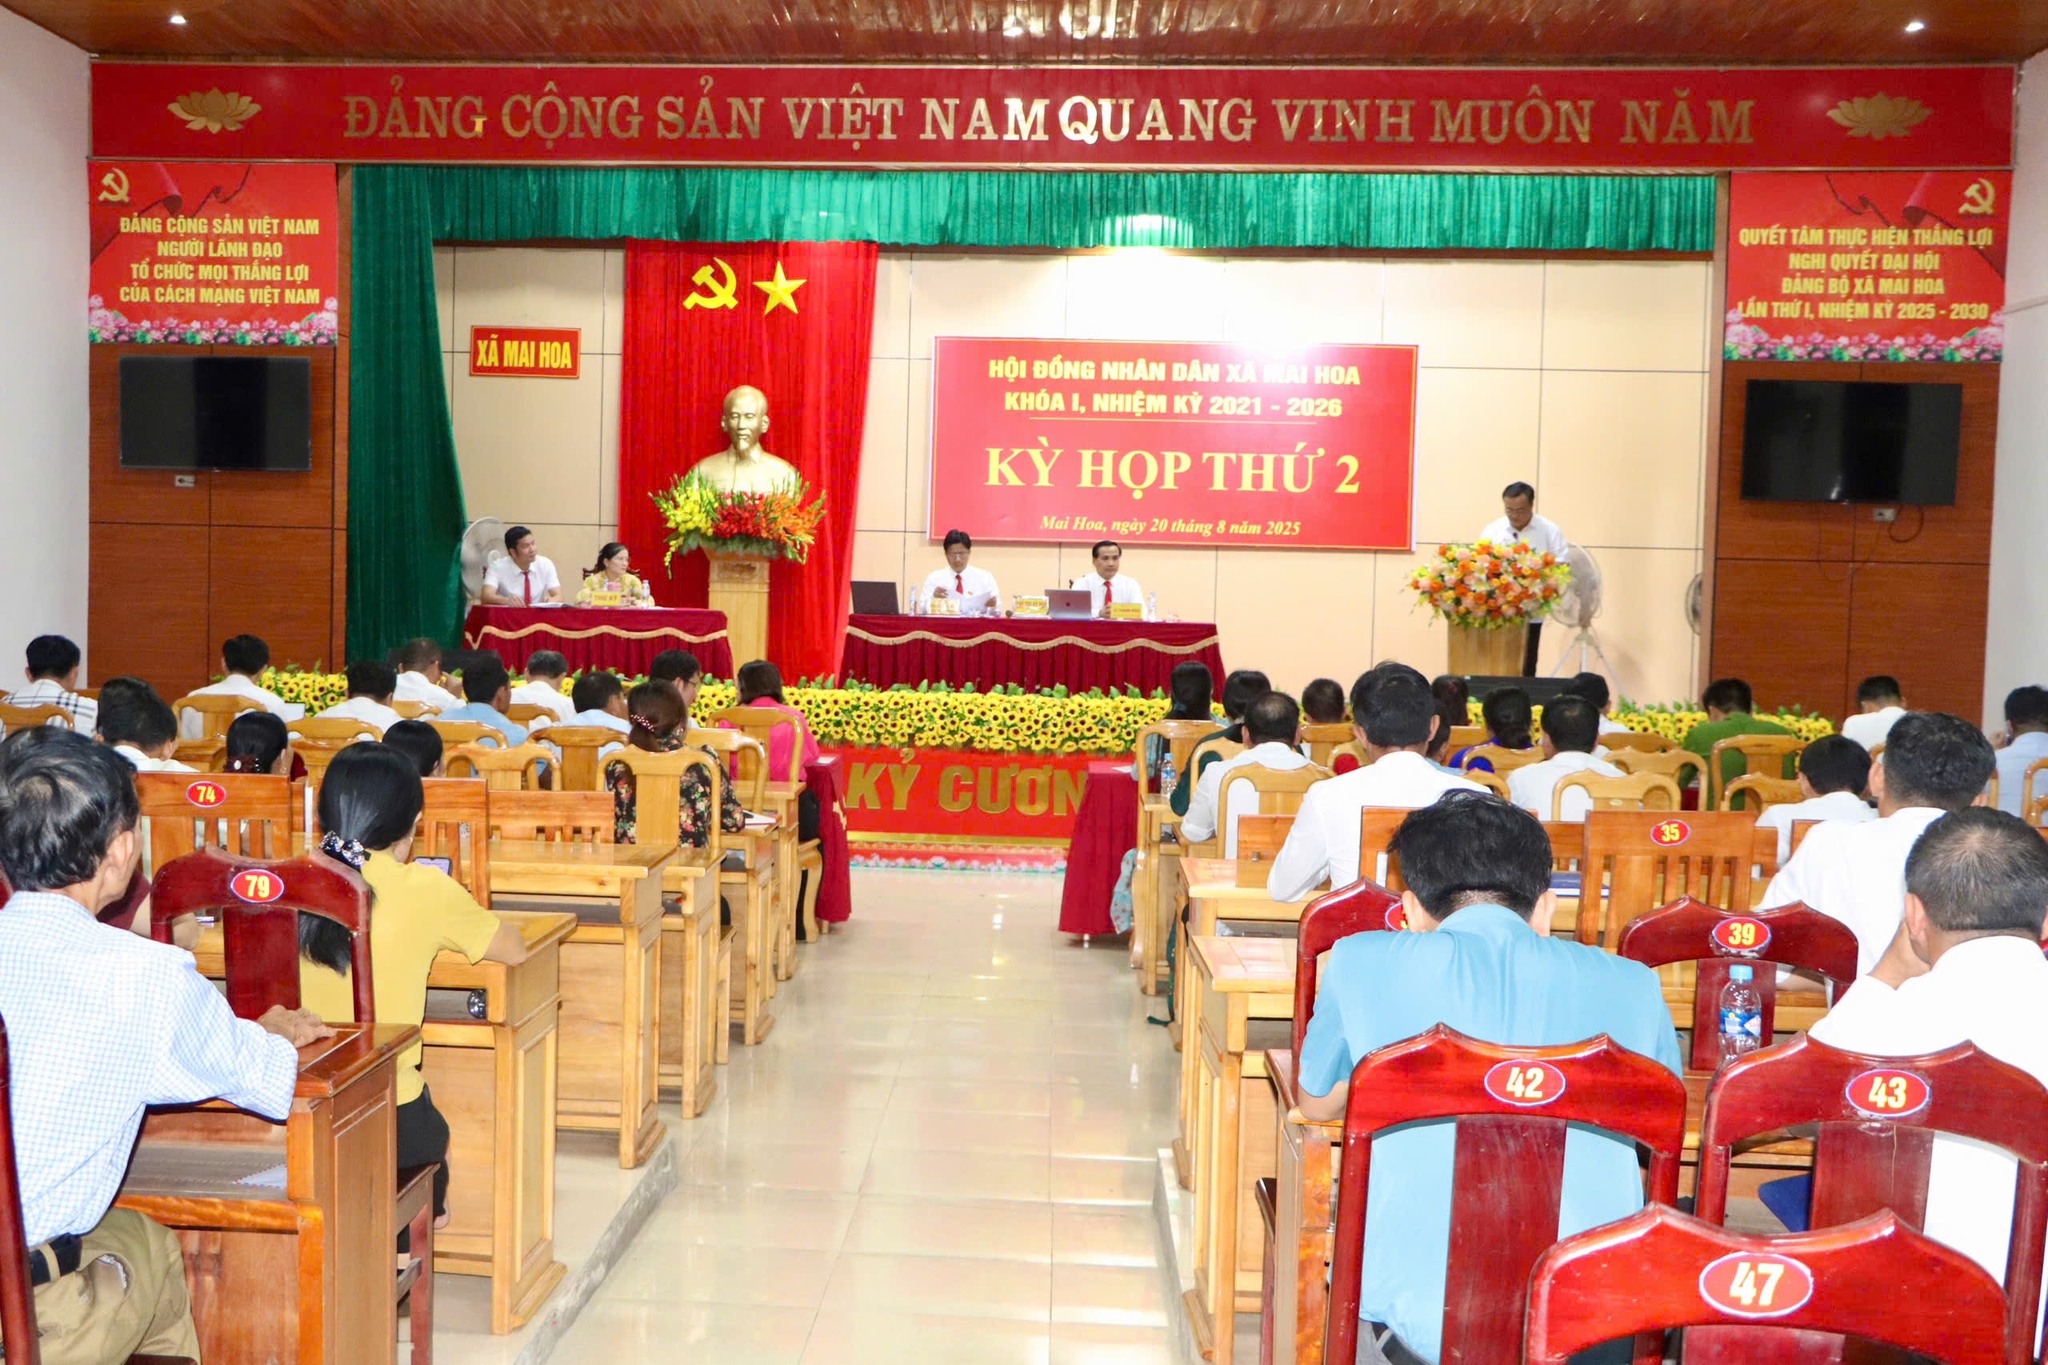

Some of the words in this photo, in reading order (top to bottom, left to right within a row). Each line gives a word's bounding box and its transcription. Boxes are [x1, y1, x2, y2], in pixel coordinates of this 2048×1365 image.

[343, 75, 487, 139] ĐẢNG
[502, 81, 643, 149] CỘNG
[656, 75, 763, 140] SẢN
[782, 82, 903, 150] VIỆT
[920, 98, 1050, 141] NAM
[1058, 95, 1256, 144] QUANG
[1272, 98, 1415, 143] VINH
[1430, 84, 1595, 144] MUÔN
[1620, 87, 1755, 144] NĂM
[120, 212, 162, 233] ĐẢNG
[167, 215, 208, 236] CỘNG
[213, 214, 244, 234] SẢN
[248, 216, 280, 238] VIỆT
[284, 219, 320, 235] NAM
[1739, 224, 1787, 247] QUYẾT
[1791, 226, 1824, 246] TÂM
[1828, 227, 1868, 249] THỰC
[1872, 226, 1909, 249] HIỆN
[1913, 223, 1964, 246] THẮNG
[1968, 227, 1993, 249] LỢI
[157, 238, 204, 257] NGƯỜI
[209, 239, 248, 258] LÃNH
[252, 242, 283, 261] ĐẠO
[1789, 253, 1826, 273] NGHỊ
[1831, 249, 1878, 271] QUYẾT
[1882, 253, 1909, 274] ĐẠI
[1914, 251, 1940, 274] HỘI
[130, 257, 150, 280] TỔ
[154, 261, 194, 281] CHỨC
[199, 265, 228, 283] MỌI
[232, 260, 282, 281] THẮNG
[286, 263, 309, 284] LỢI
[120, 282, 150, 303] CỦA
[154, 284, 195, 303] CÁCH
[200, 288, 245, 306] MẠNG
[249, 285, 281, 306] VIỆT
[285, 289, 320, 304] NAM
[1781, 273, 1824, 295] ĐẢNG
[1828, 275, 1850, 297] BỘ
[1853, 274, 1875, 295] XÃ
[1879, 278, 1910, 295] MAI
[1914, 278, 1945, 295] HOA
[1771, 299, 1804, 319] THỨ
[1819, 298, 1870, 322] NHIỆM
[1873, 299, 1894, 319] KỲ
[1897, 303, 1936, 320] 2025
[1950, 303, 1989, 320] 2030
[476, 333, 499, 367] XÃ
[503, 340, 536, 368] MAI
[538, 341, 572, 369] HOA
[988, 356, 1027, 383] HỘI
[1101, 358, 1166, 382] NHÂN
[1172, 359, 1220, 383] DÂN
[1225, 361, 1257, 384] XÃ
[1263, 364, 1308, 385] MAI
[1314, 365, 1361, 386] HOA
[1005, 388, 1065, 411] KHÓA
[1071, 393, 1086, 414] I,
[1093, 390, 1167, 416] NHIỆM
[1173, 391, 1203, 415] KỲ
[1209, 396, 1261, 415] 2021
[1286, 397, 1343, 417] 2026
[984, 436, 1064, 486] KỲ
[1076, 449, 1192, 500] HỌP
[1202, 442, 1327, 493] THỨ
[1334, 455, 1360, 493] 2
[1039, 515, 1069, 531] Mai
[1072, 516, 1108, 533] Hoa,
[1111, 518, 1148, 536] ngày
[1150, 518, 1168, 533] 20
[1171, 517, 1212, 537] tháng
[1217, 520, 1226, 534] 8
[1229, 520, 1262, 535] năm
[1264, 521, 1301, 536] 2025
[197, 786, 216, 803] 74
[844, 748, 921, 811] KỶ
[938, 764, 1088, 816] CƯƠN
[1661, 824, 1680, 842] 35
[245, 875, 270, 898] 79
[1728, 923, 1755, 945] 39
[1506, 1067, 1544, 1098] 42
[1869, 1078, 1906, 1110] 43
[1729, 1262, 1785, 1306] 47
